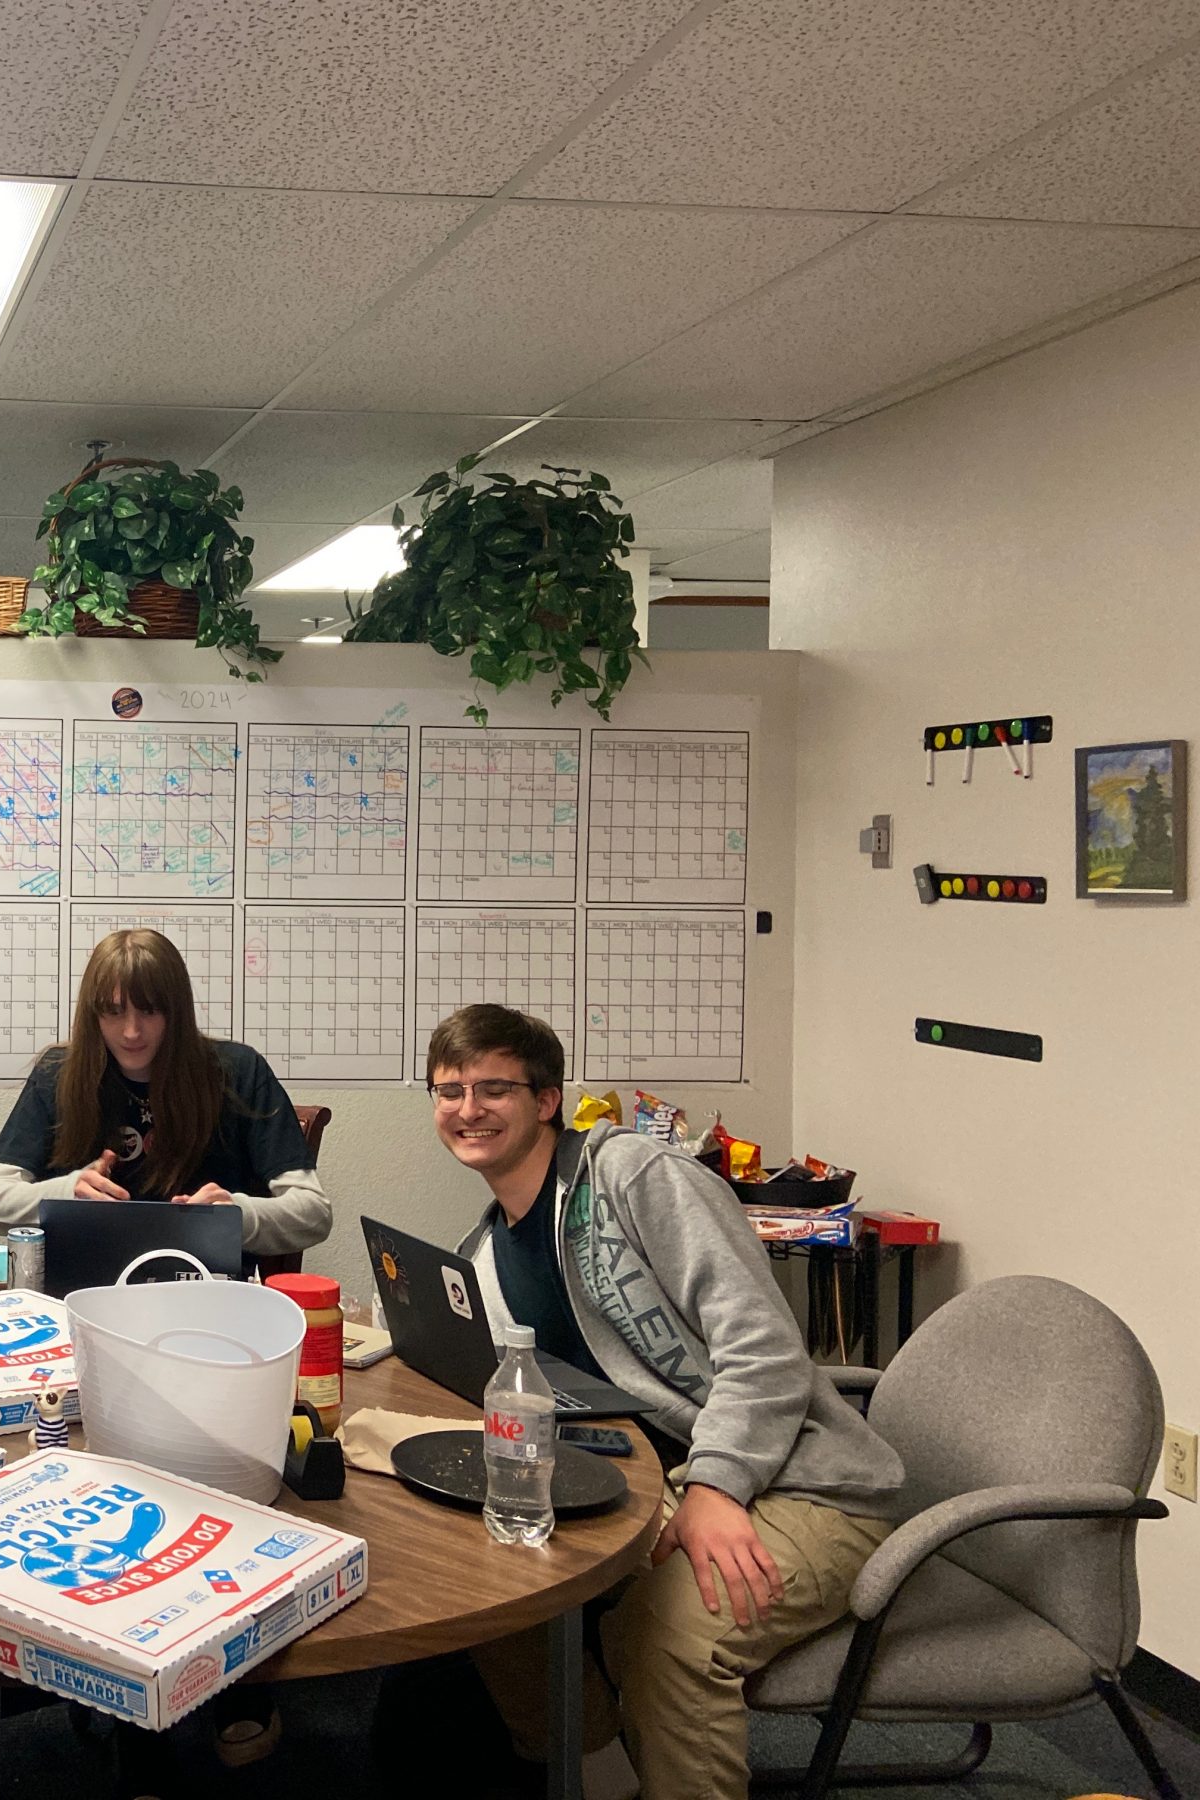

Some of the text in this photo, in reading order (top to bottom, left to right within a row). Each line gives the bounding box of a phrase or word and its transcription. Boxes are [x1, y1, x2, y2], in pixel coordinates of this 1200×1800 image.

[180, 691, 232, 709] 2024
[593, 1193, 706, 1393] SALEM
[6, 1351, 61, 1367] YOUR
[16, 1498, 71, 1514] PIZZA
[76, 1520, 223, 1601] DO YOUR SLICE
[310, 1568, 361, 1608] S M L XL
[140, 1618, 164, 1627] L
[244, 1622, 261, 1646] 72
[54, 1668, 124, 1706] REWARDS
[171, 1688, 186, 1702] OUR
[188, 1668, 219, 1696] GUARANTEE
